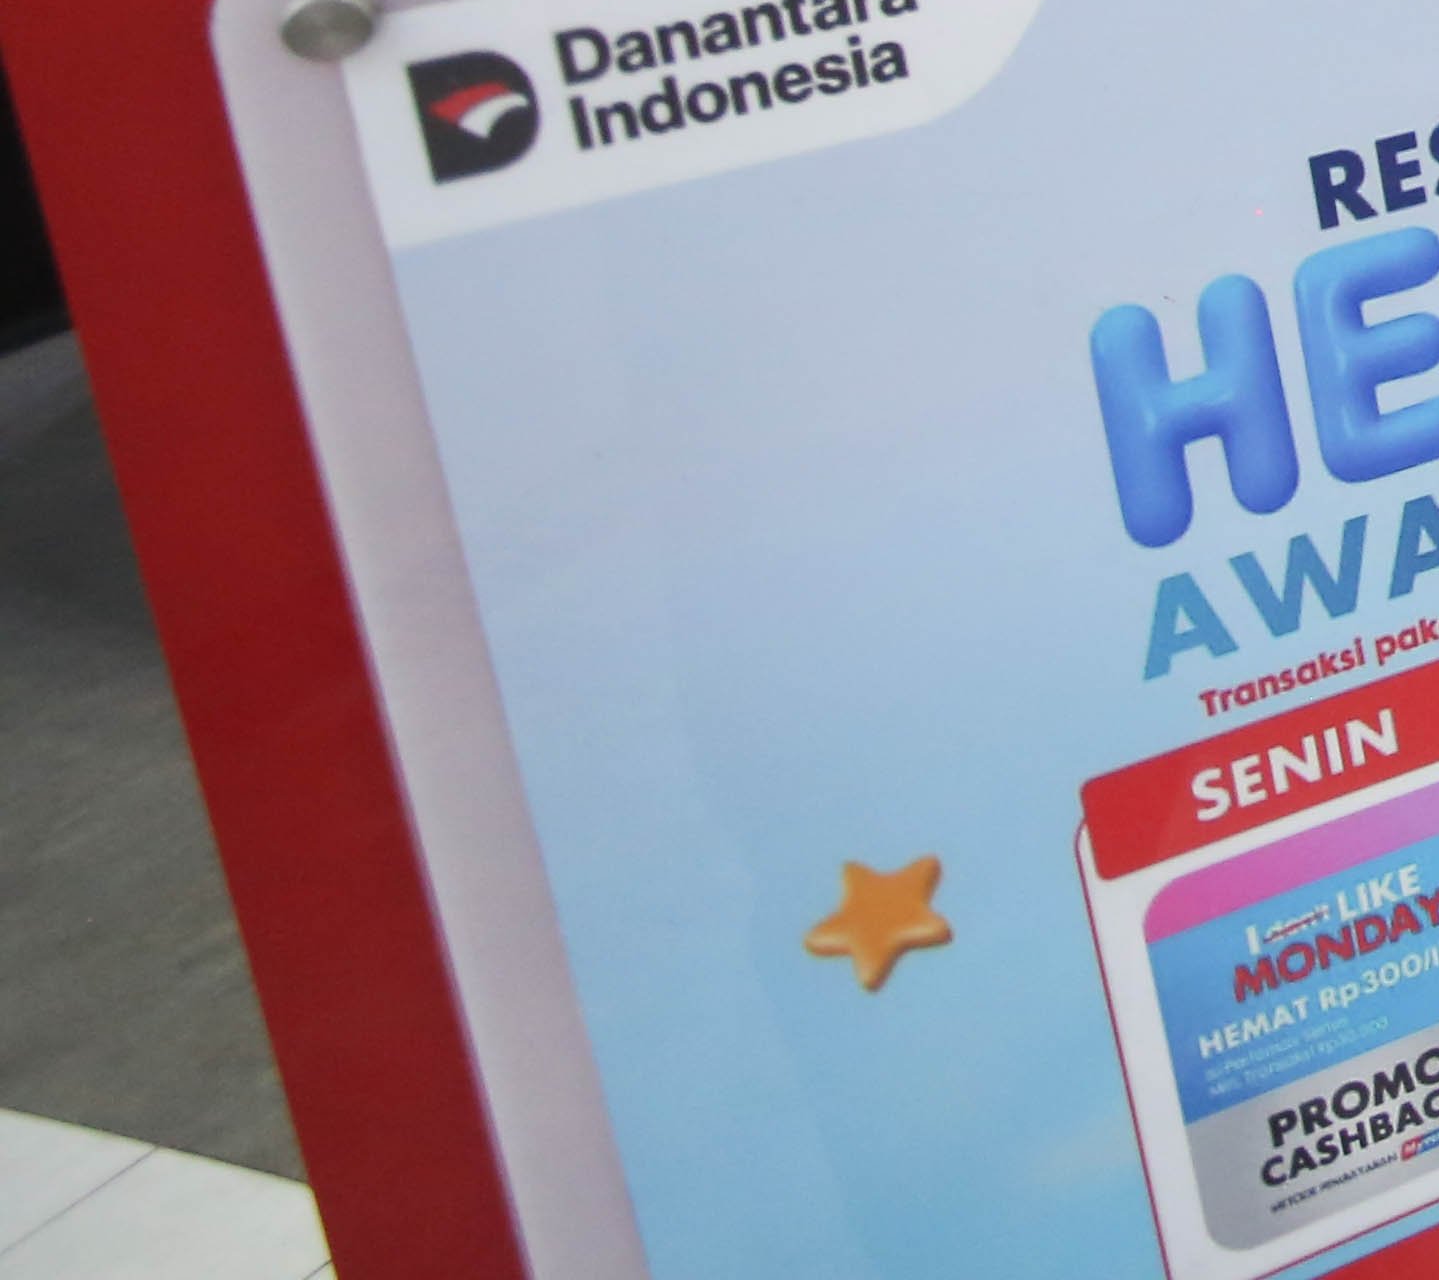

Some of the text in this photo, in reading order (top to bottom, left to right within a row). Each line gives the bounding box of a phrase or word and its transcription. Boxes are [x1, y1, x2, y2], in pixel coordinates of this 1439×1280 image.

[567, 36, 910, 151] Indonesia
[1198, 638, 1365, 717] Transaksi
[1190, 708, 1401, 822] SENIN
[1335, 863, 1422, 922] LIKE
[1198, 995, 1310, 1060] HEMAT
